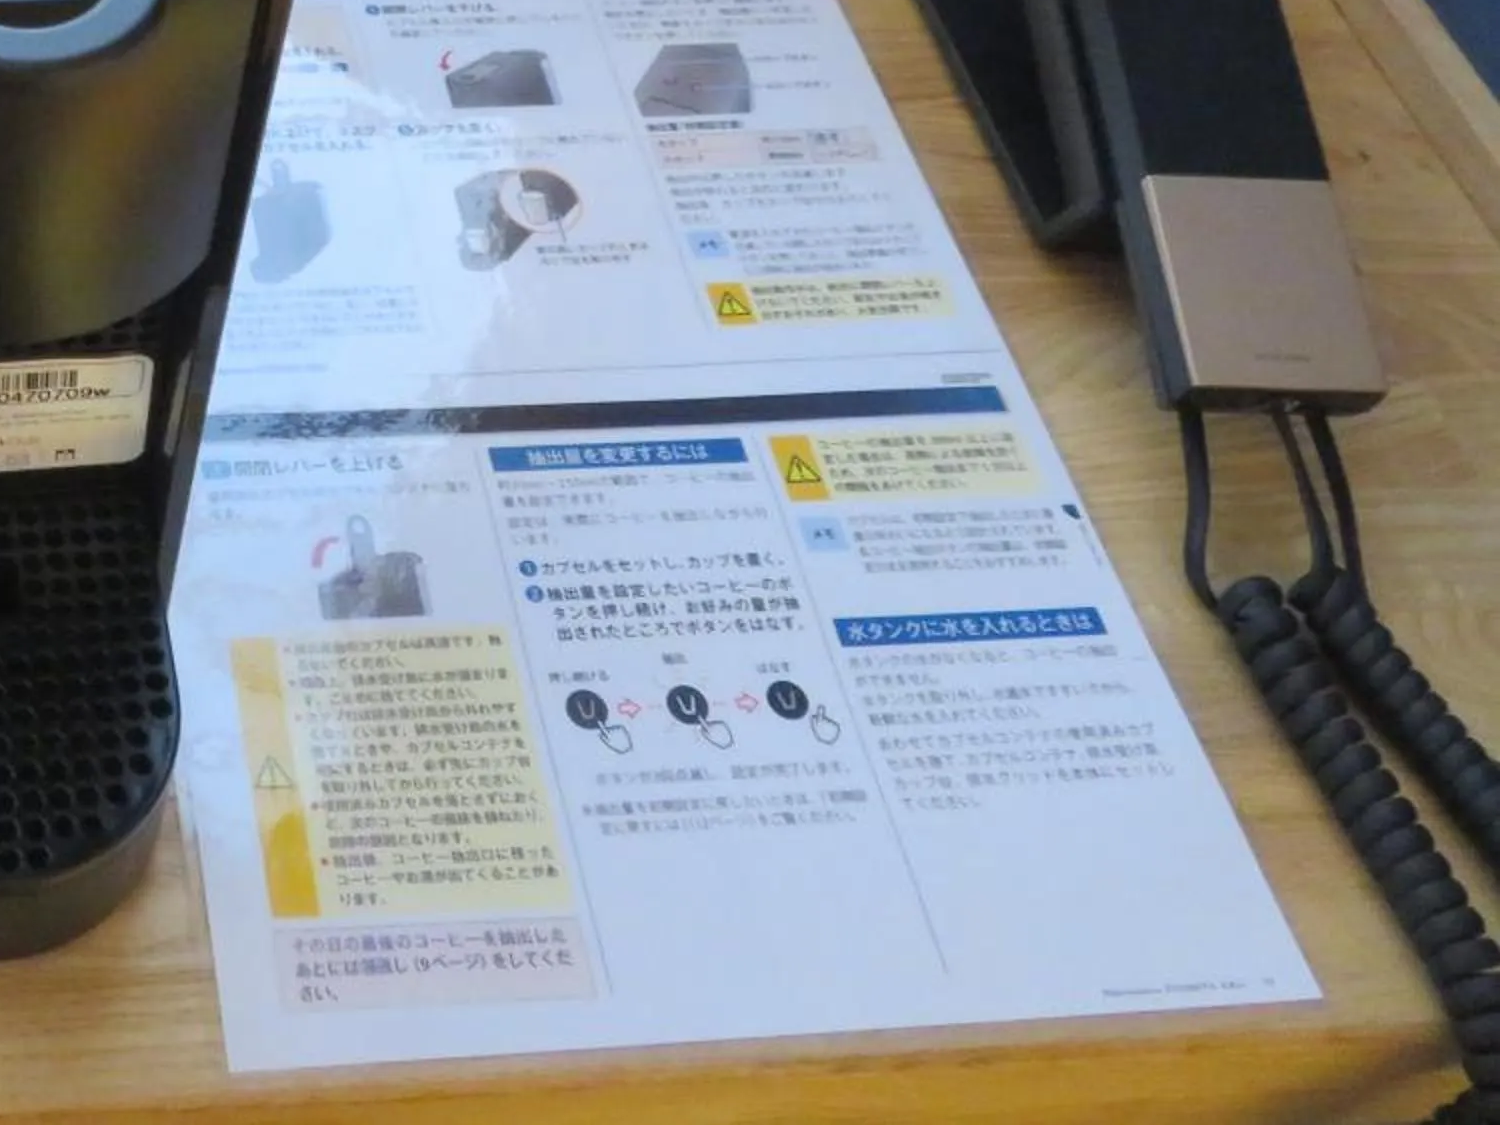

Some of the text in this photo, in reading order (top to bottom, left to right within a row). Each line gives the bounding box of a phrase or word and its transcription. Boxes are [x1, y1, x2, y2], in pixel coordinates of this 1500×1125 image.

[528, 445, 710, 464] 抽出量を変更するには
[845, 614, 1095, 639] 水タンクに水を入れるときは
